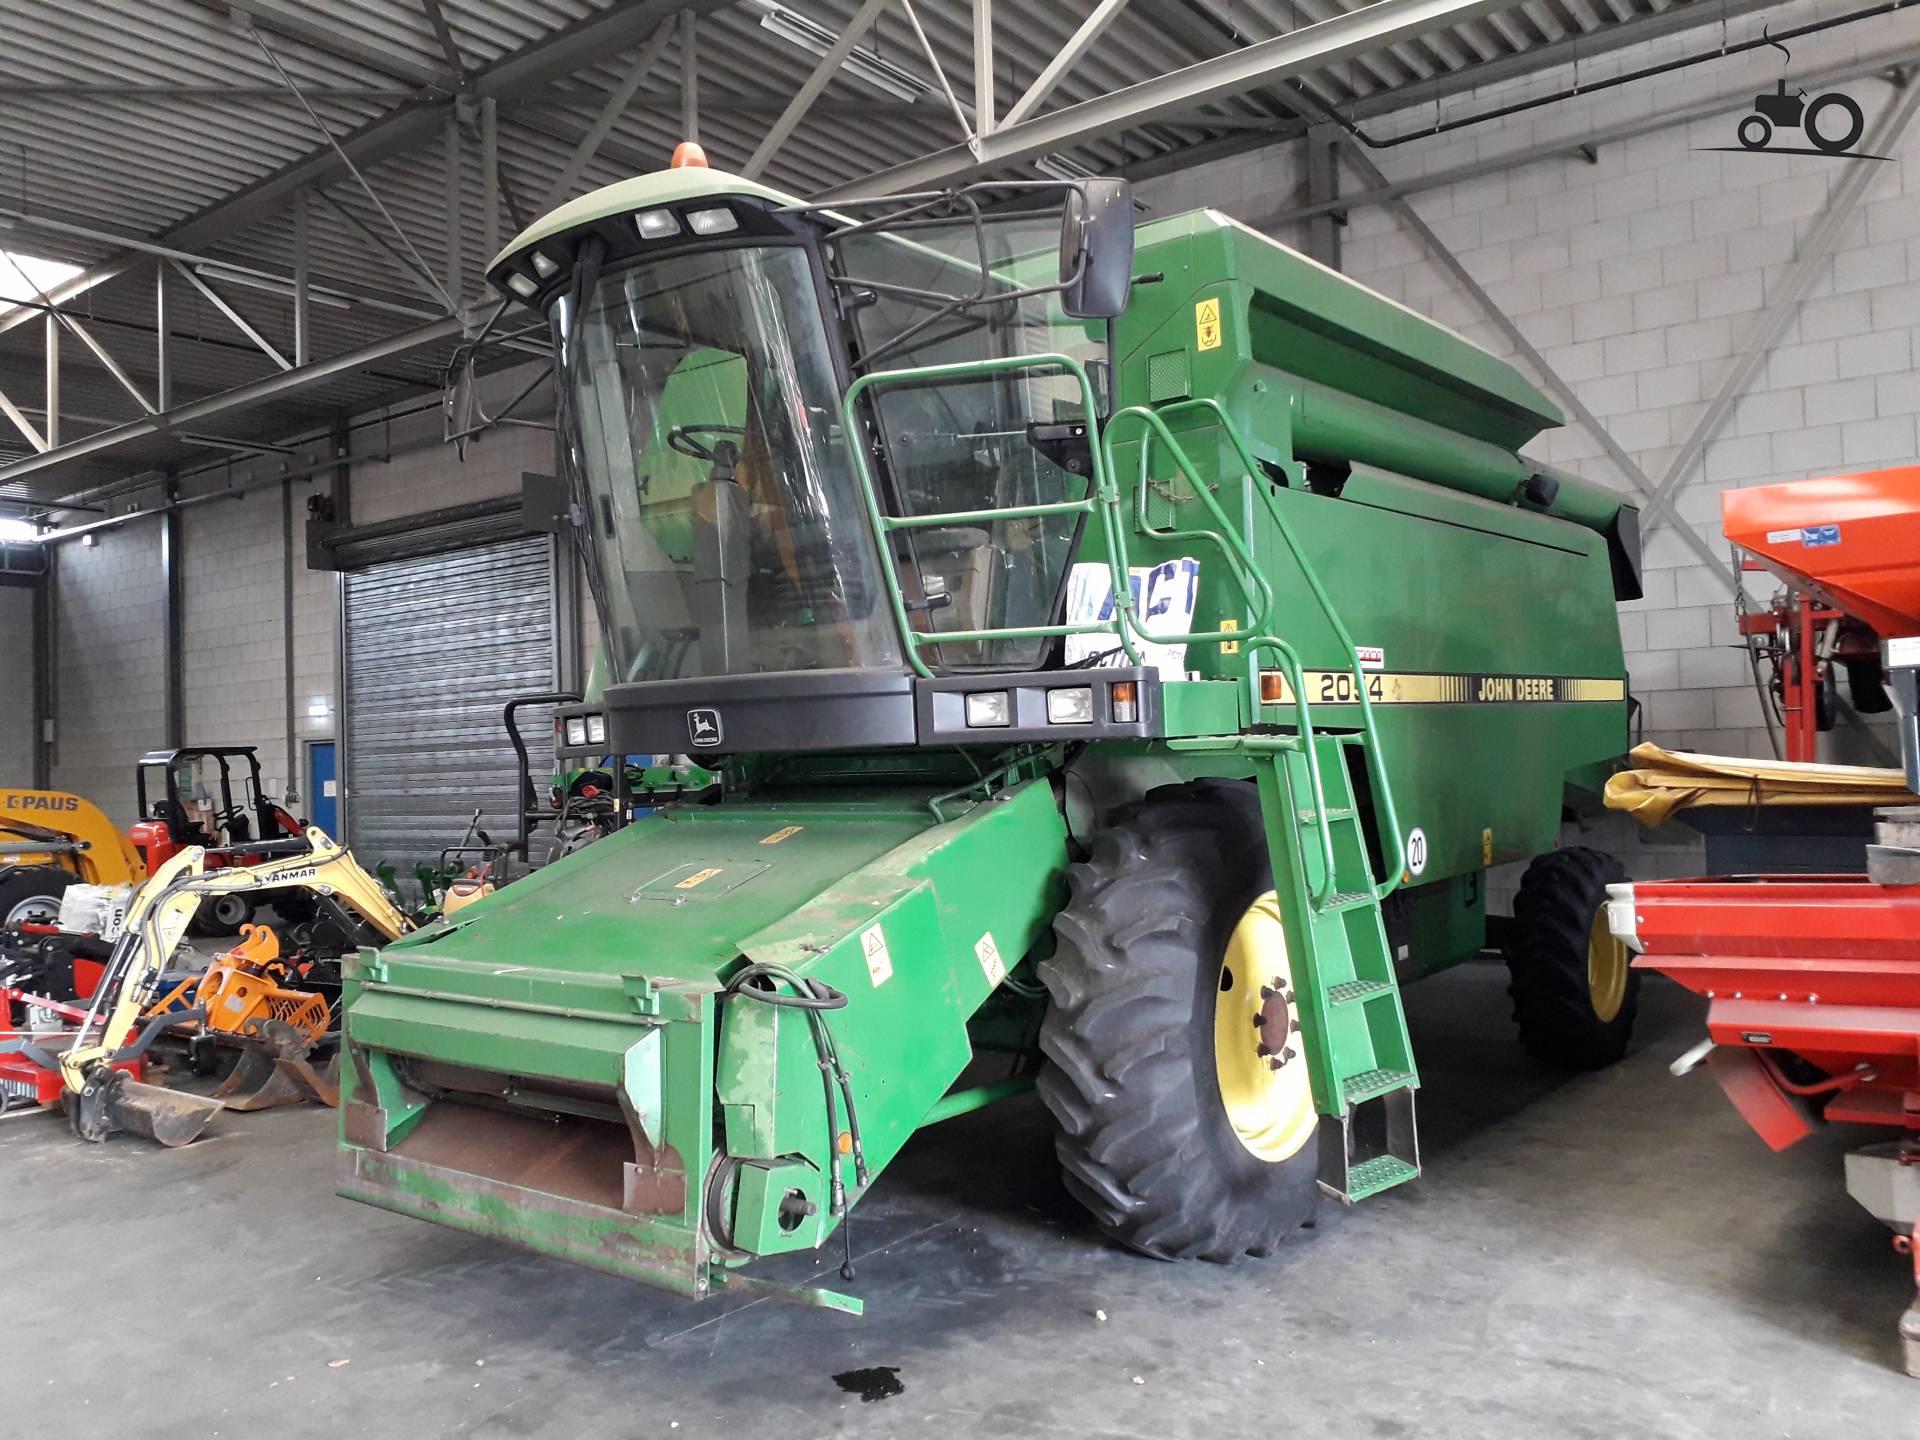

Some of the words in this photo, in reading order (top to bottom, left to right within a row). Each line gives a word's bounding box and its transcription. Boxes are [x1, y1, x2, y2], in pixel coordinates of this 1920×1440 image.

[1478, 677, 1513, 702] JOHN
[1515, 678, 1554, 701] DEERE
[22, 796, 79, 812] PAUS
[1411, 836, 1423, 867] 20
[264, 868, 316, 883] YANMAR
